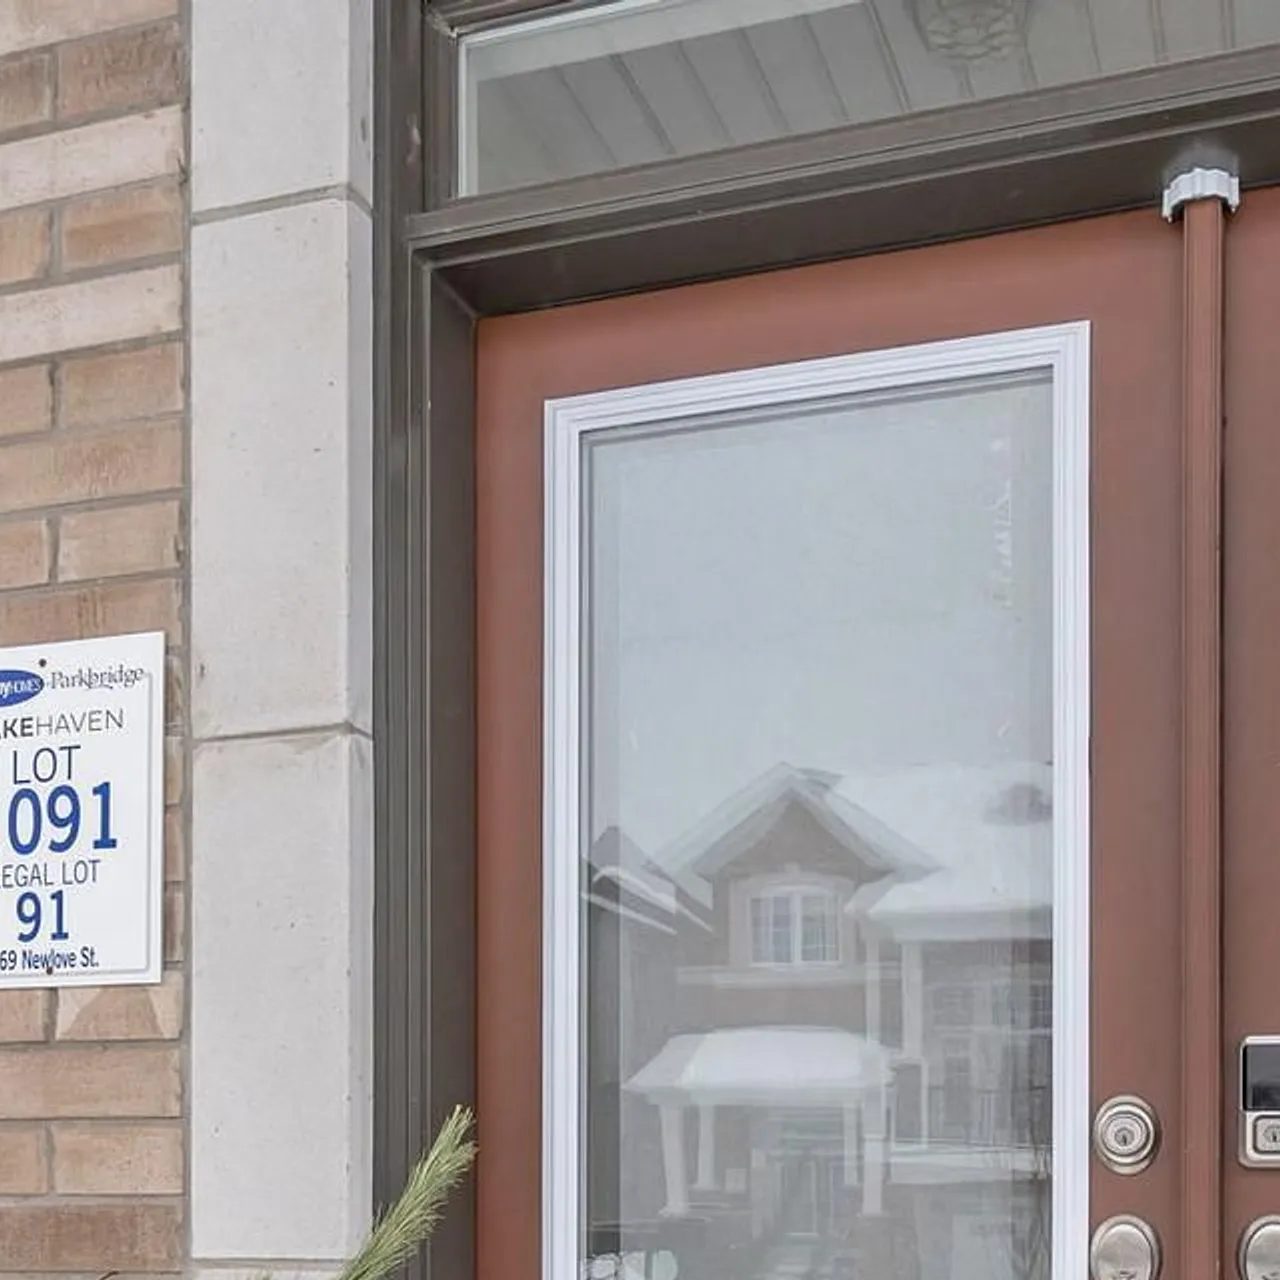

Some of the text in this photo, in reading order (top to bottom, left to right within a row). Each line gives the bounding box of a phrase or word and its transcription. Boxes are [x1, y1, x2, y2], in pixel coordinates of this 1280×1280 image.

[51, 664, 144, 689] Parkbridge
[13, 745, 81, 785] LOT
[62, 859, 101, 885] LOT
[16, 889, 69, 942] 91
[22, 947, 77, 970] Newlove
[80, 945, 100, 968] St.
